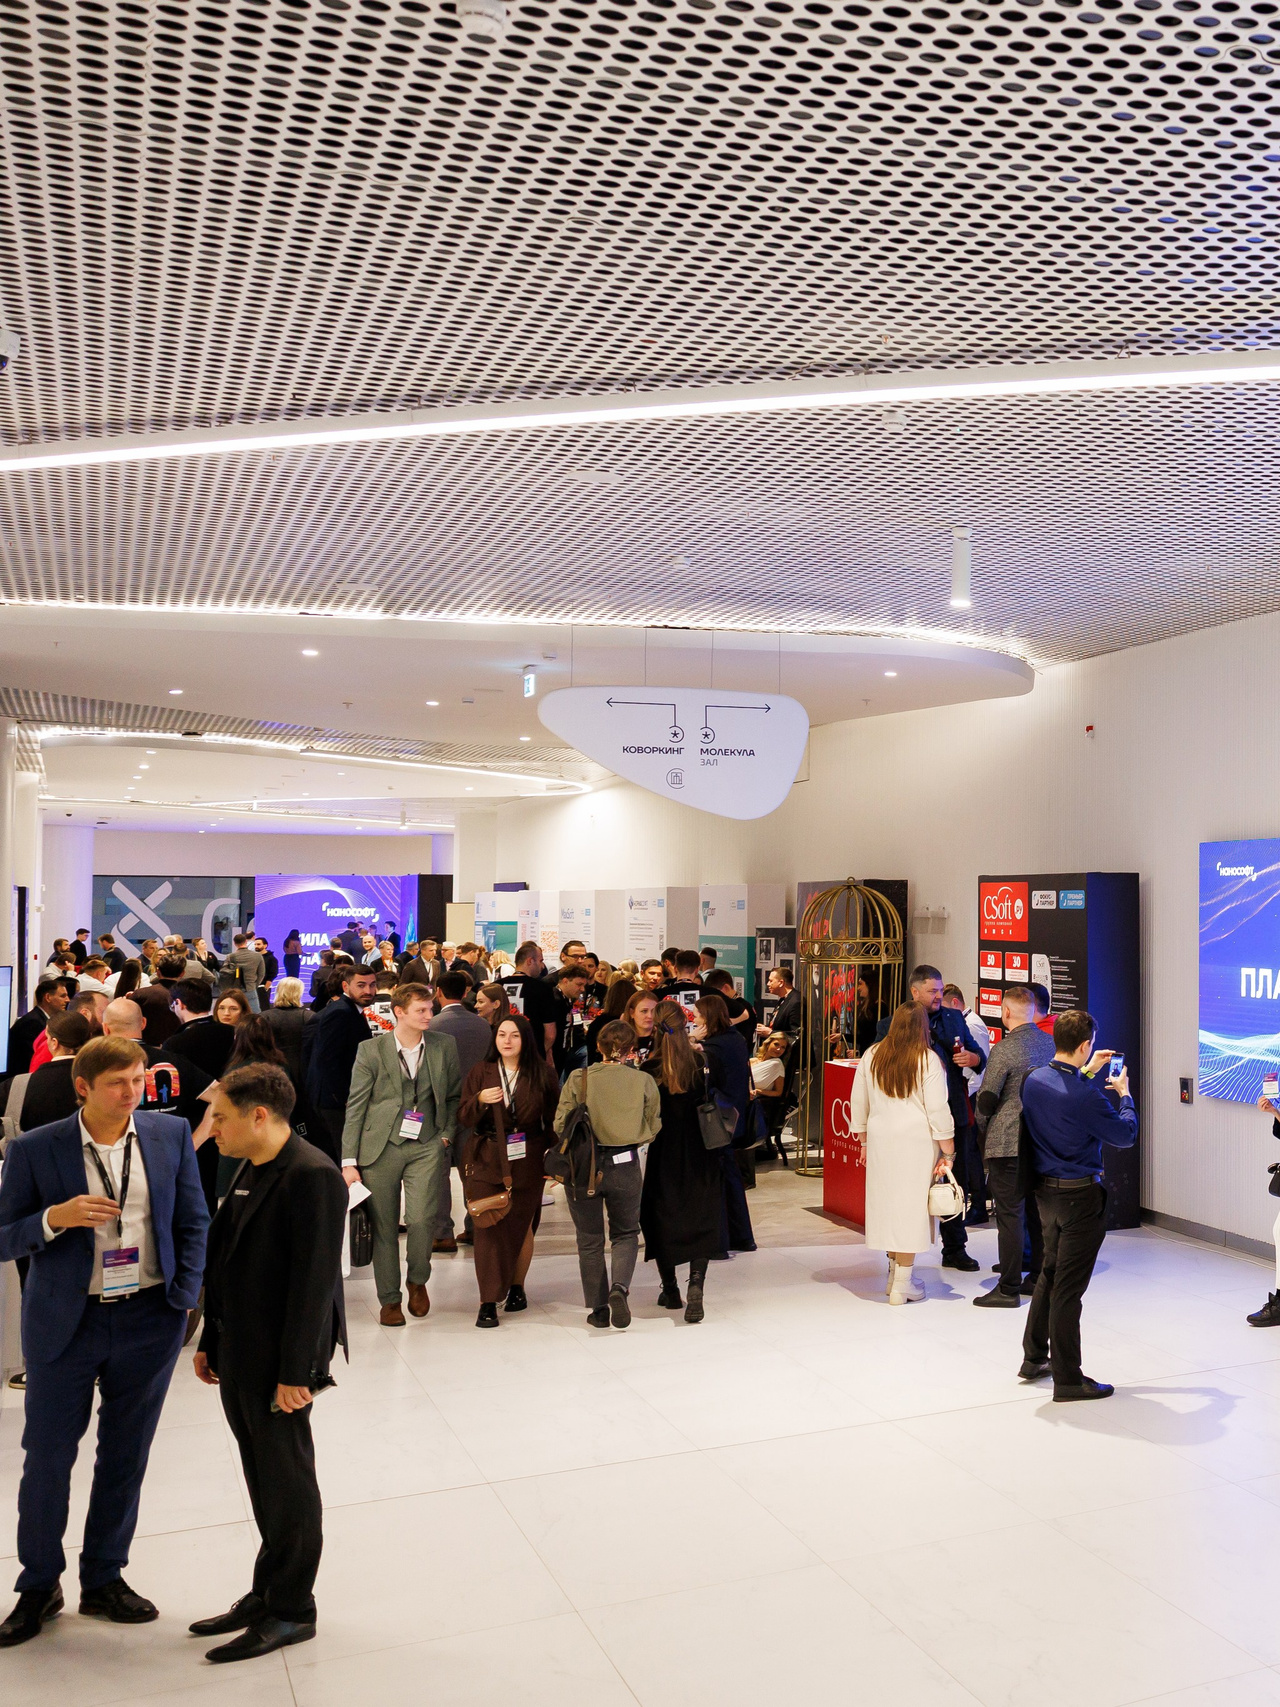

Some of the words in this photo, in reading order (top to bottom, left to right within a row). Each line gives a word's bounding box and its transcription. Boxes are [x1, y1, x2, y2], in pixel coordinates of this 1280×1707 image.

[622, 745, 685, 755] КОВОРКИНГ
[699, 747, 756, 757] МОЛЕКУЛА
[699, 758, 718, 767] ЗАЛ
[984, 888, 1013, 920] CSoft
[299, 932, 331, 947] ИЛА
[986, 954, 996, 966] 50
[1012, 955, 1022, 968] 30
[831, 1098, 859, 1142] CS
